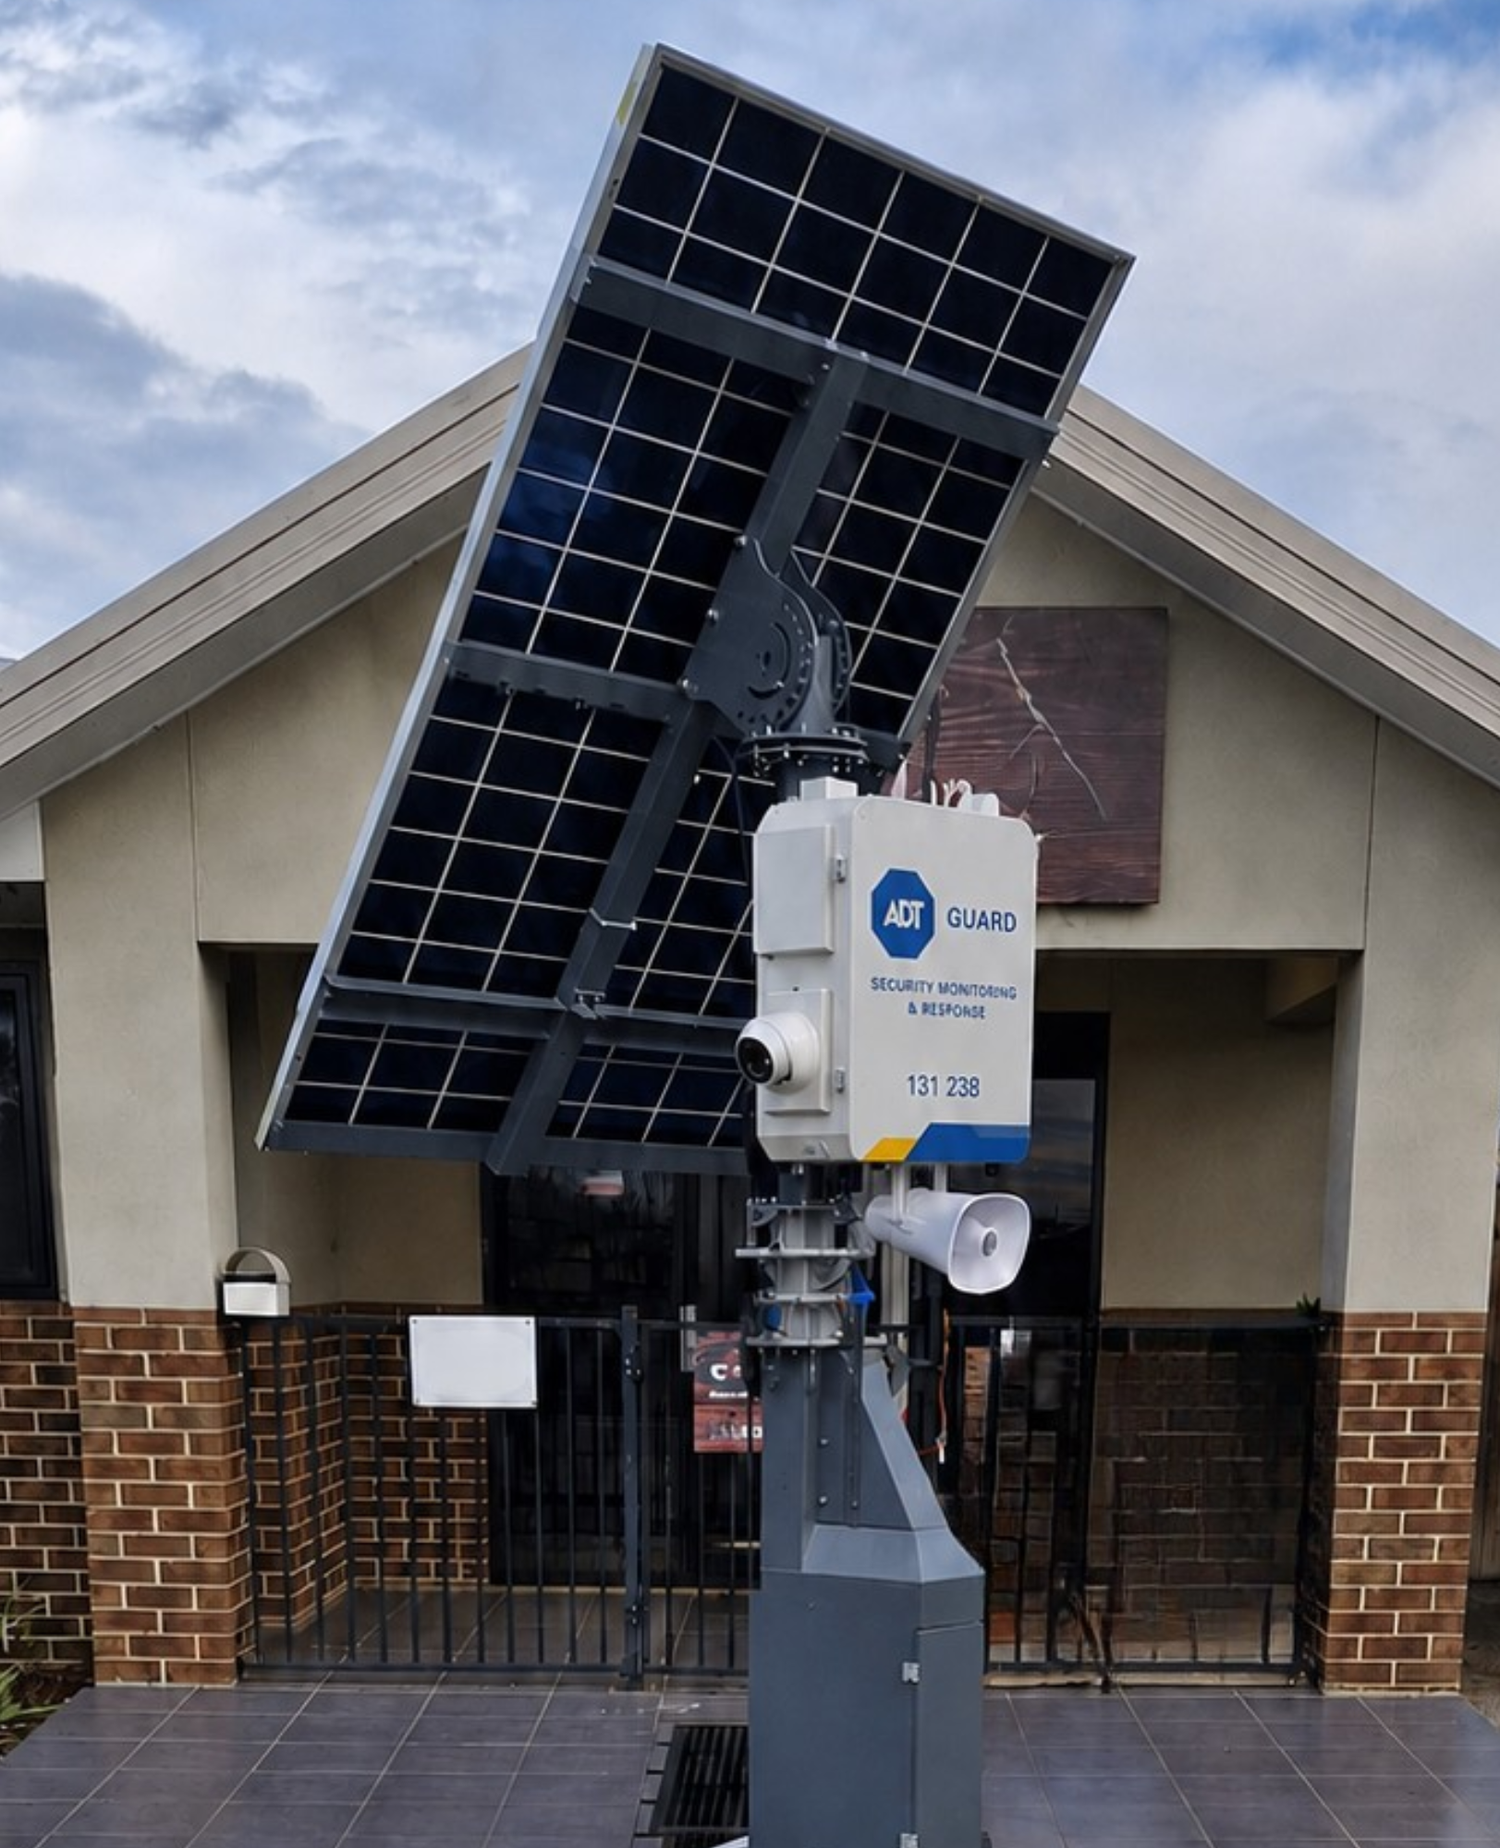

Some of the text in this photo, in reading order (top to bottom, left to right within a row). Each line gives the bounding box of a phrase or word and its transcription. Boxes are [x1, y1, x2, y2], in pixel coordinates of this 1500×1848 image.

[883, 899, 1017, 933] ADT GUARD
[871, 977, 934, 994] SECURITY
[907, 1074, 980, 1098] 131 238
